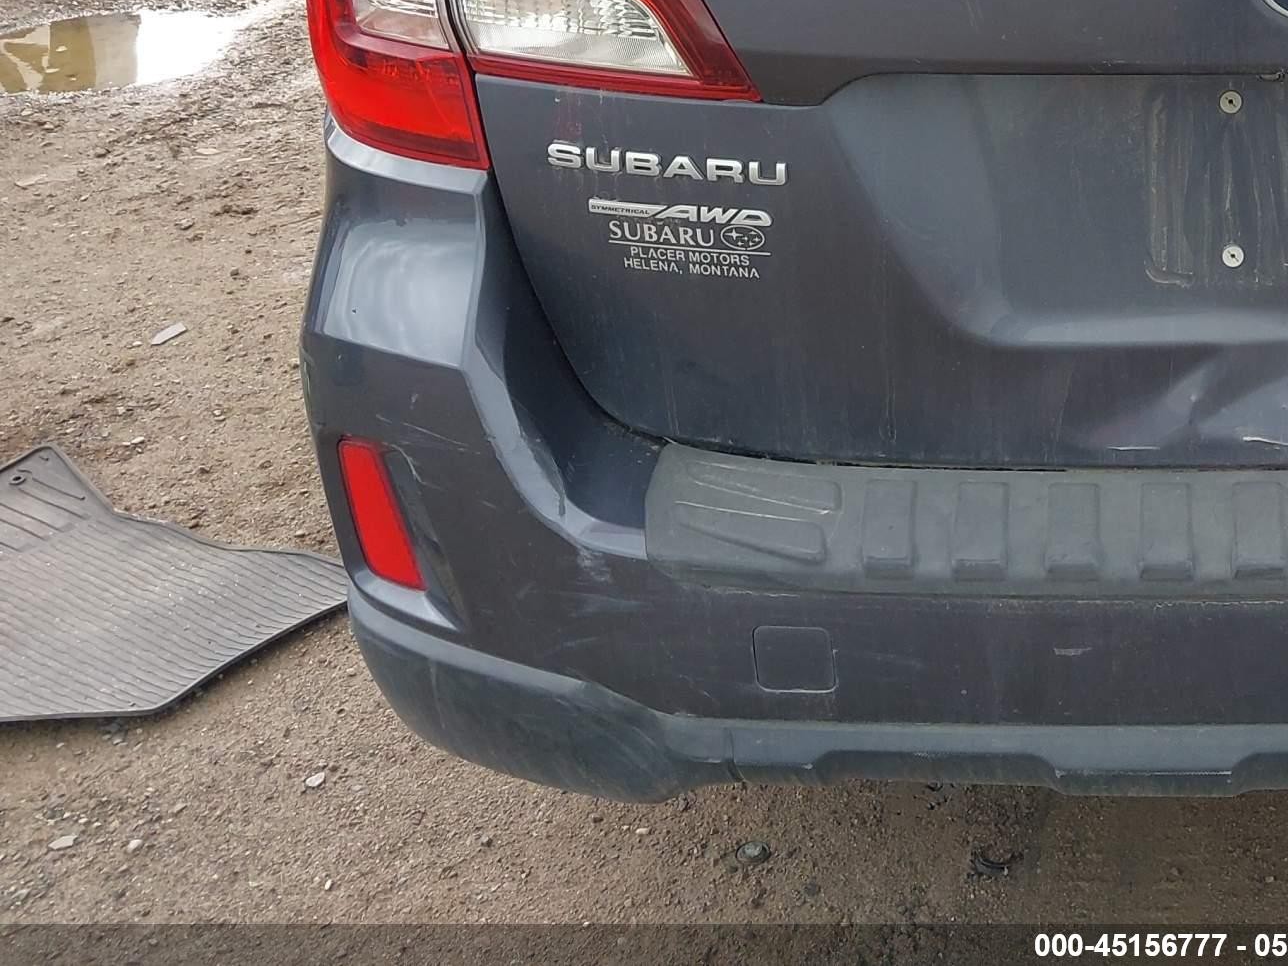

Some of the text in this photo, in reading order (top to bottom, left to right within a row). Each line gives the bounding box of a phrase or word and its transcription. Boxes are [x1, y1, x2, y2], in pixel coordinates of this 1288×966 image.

[547, 141, 787, 185] SUBARU
[591, 204, 772, 226] SYMMETRICAL AWD
[608, 220, 714, 247] SUBARU
[630, 246, 750, 266] PLACER MOTORS
[624, 257, 760, 279] HELENA, MONTANA
